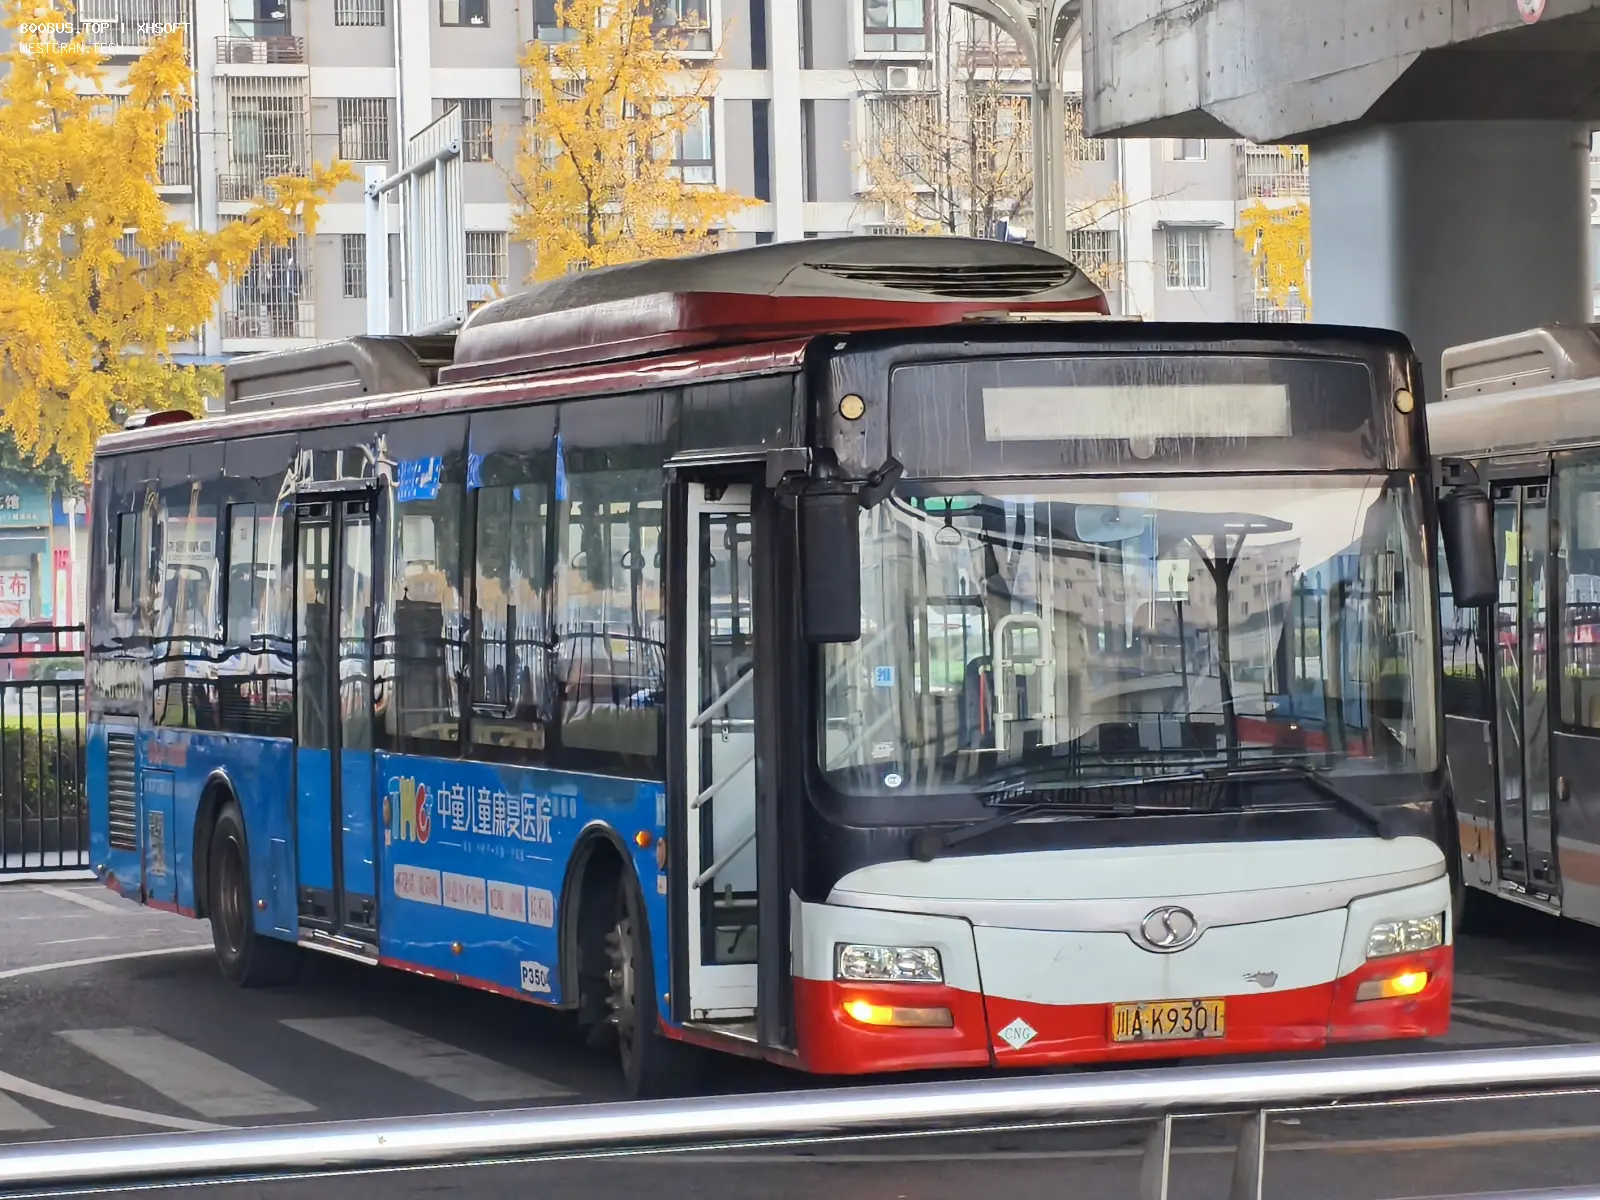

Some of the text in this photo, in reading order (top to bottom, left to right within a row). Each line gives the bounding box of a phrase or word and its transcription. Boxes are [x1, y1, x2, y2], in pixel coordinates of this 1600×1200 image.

[437, 780, 553, 844] 中童儿童康复医院
[1004, 1026, 1031, 1041] CNG
